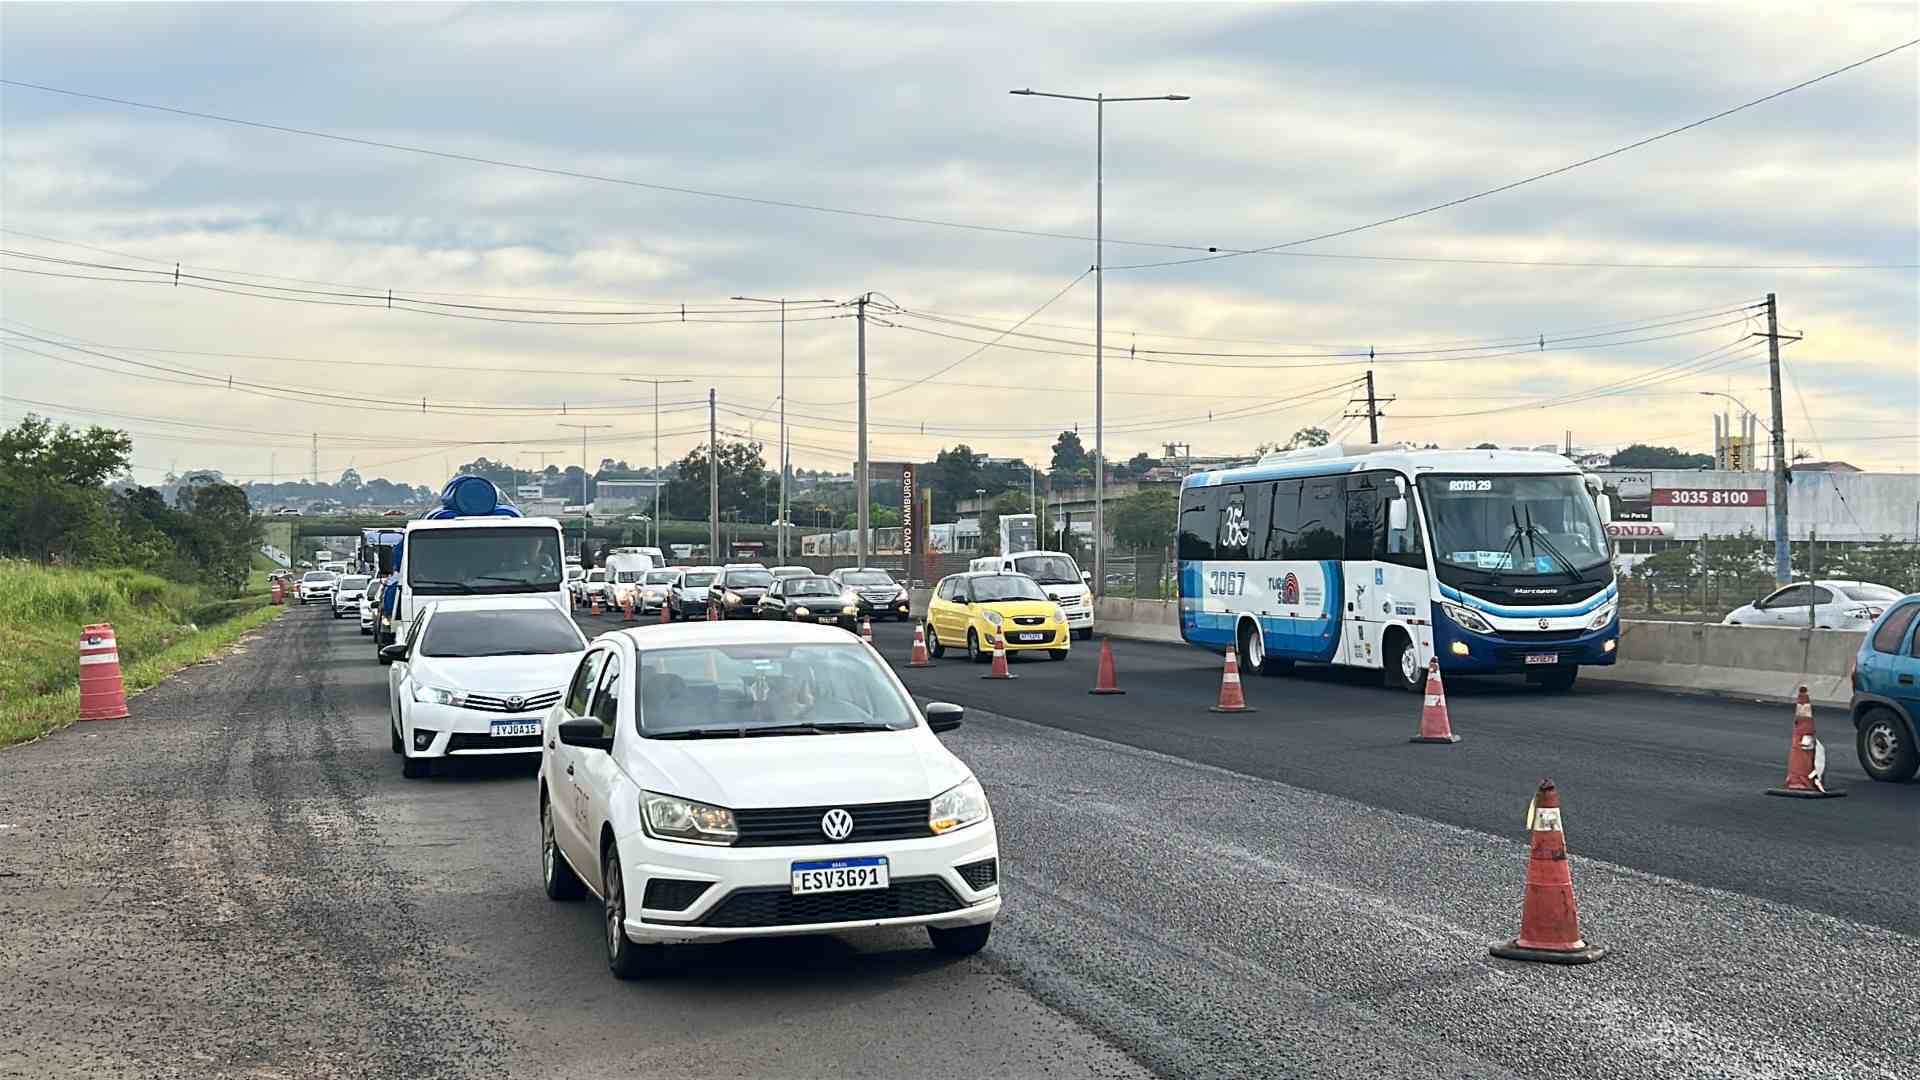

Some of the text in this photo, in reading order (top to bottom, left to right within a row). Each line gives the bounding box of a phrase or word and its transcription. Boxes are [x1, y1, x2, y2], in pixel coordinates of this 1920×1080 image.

[1449, 480, 1492, 491] ROTA 29
[1671, 491, 1749, 504] 3035 8100
[903, 471, 911, 555] NOVO HAMBURGO
[1607, 525, 1665, 536] ONDA
[1209, 571, 1246, 596] 3067
[802, 868, 879, 890] ESV3G91
